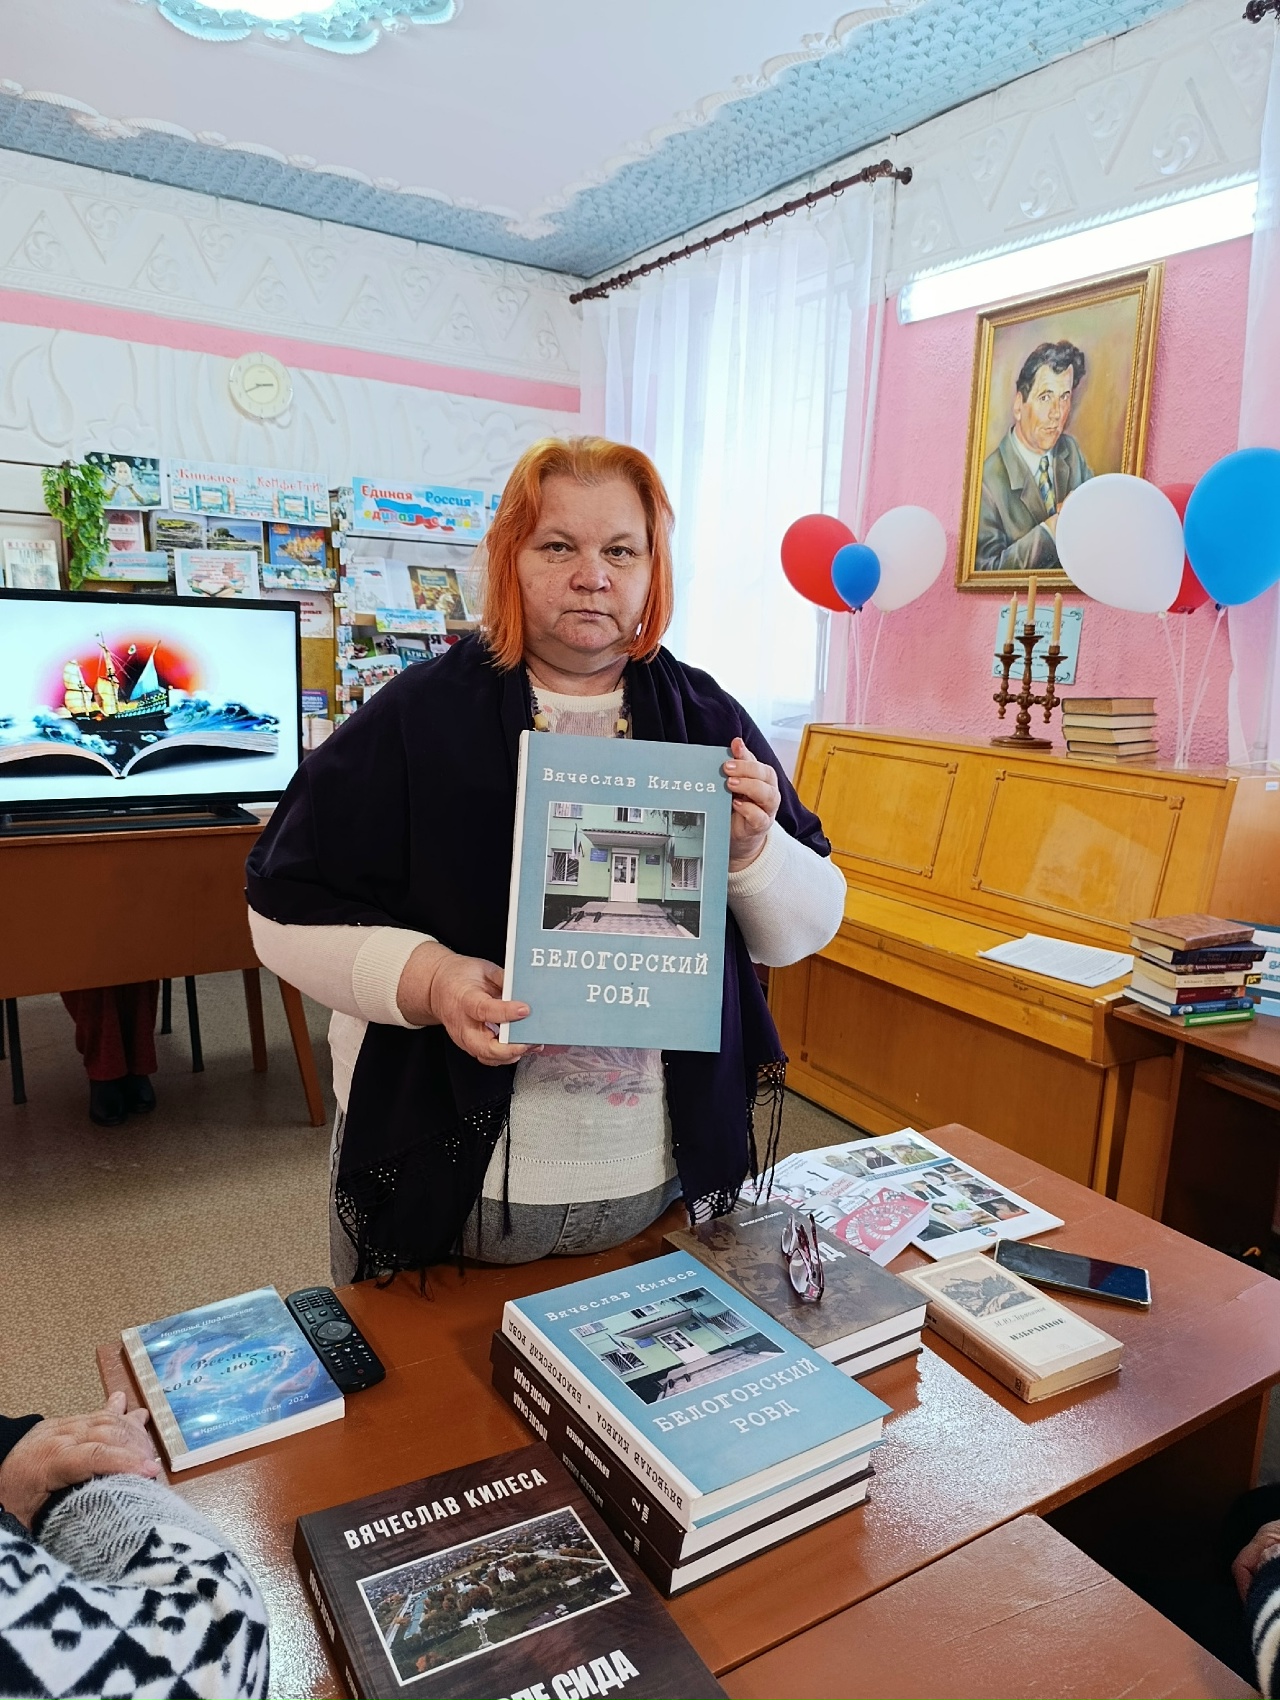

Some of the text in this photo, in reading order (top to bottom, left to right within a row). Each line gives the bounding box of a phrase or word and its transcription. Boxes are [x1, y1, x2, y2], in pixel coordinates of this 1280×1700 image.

[362, 485, 413, 500] Единая
[425, 491, 471, 507] Россия
[364, 510, 416, 523] единая
[542, 767, 717, 793] Вячеслав Килеса
[530, 948, 709, 975] БЕЛОГОРСКИЙ
[586, 984, 651, 1008] РОВД
[544, 1268, 697, 1322] Вячеслав Килеса
[1009, 1317, 1067, 1342] ИЗБРАННОЕ
[163, 1375, 203, 1394] кого
[513, 1366, 530, 1393] СИДА
[513, 1391, 529, 1417] СИДА
[530, 1386, 551, 1415] ПОСЛЕ
[652, 1357, 820, 1432] БЕЛОГОРСКИЙ
[200, 1393, 310, 1434] Красноперекопск 2024
[508, 1319, 683, 1510] ВЯЧЕСЛАВ КИЛЕСА БЕЛОГОРСКИЙ РОВД
[529, 1411, 548, 1441] ПОСЛЕ
[729, 1399, 801, 1434] РОВД
[343, 1468, 548, 1550] ВЯЧЕСЛАВ КИЛЕСА
[631, 1497, 641, 1512] 2
[641, 1503, 650, 1524] ТОМ
[551, 1649, 640, 1700] СИДА
